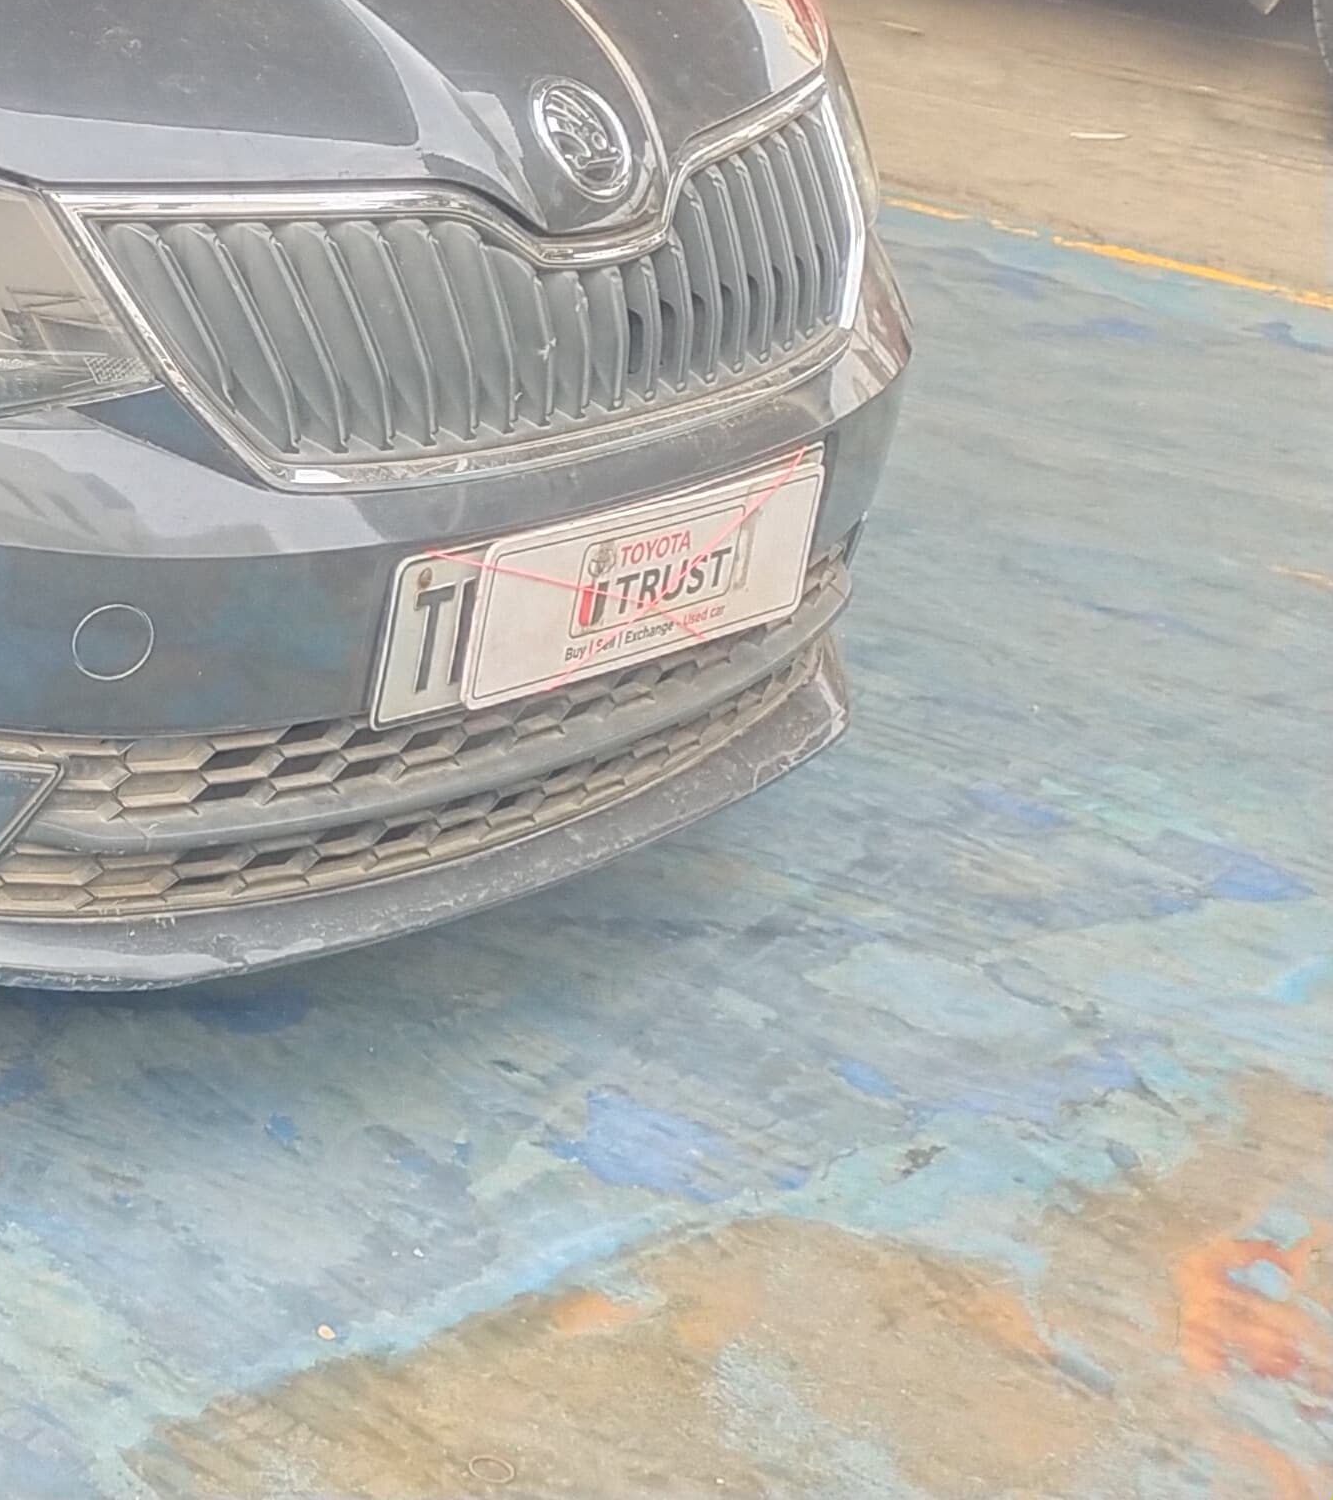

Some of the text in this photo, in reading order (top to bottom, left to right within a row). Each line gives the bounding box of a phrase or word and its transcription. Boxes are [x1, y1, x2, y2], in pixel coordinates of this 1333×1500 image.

[620, 530, 691, 568] TOYOTA
[615, 545, 733, 616] TRUST
[564, 643, 587, 662] Buy
[624, 620, 675, 645] Exchange
[682, 609, 709, 626] Used
[709, 605, 726, 619] car
